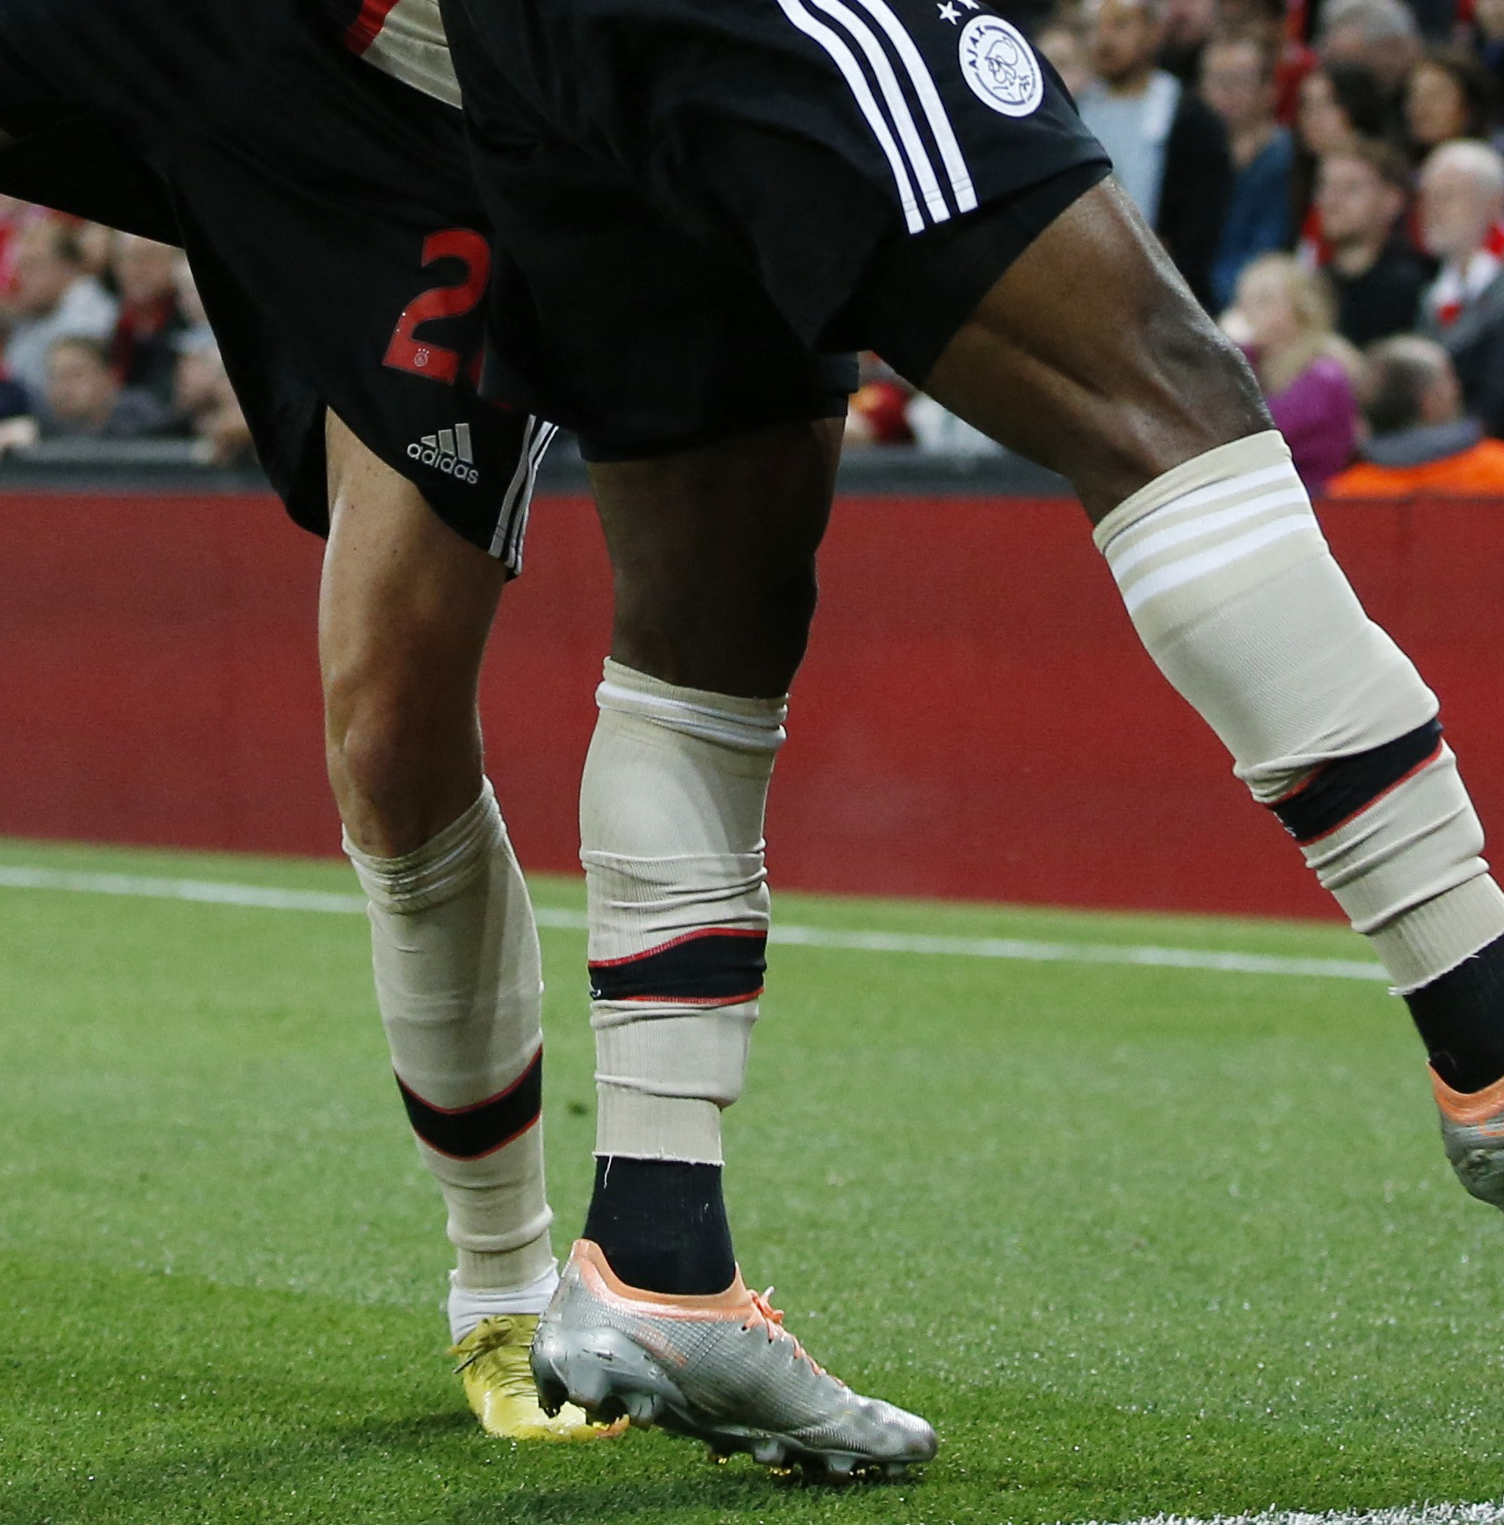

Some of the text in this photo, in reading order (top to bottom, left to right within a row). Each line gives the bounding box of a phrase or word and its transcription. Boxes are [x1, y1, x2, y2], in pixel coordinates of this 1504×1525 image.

[966, 25, 986, 70] AJAX
[381, 227, 514, 412] 2
[406, 443, 480, 485] adidas
